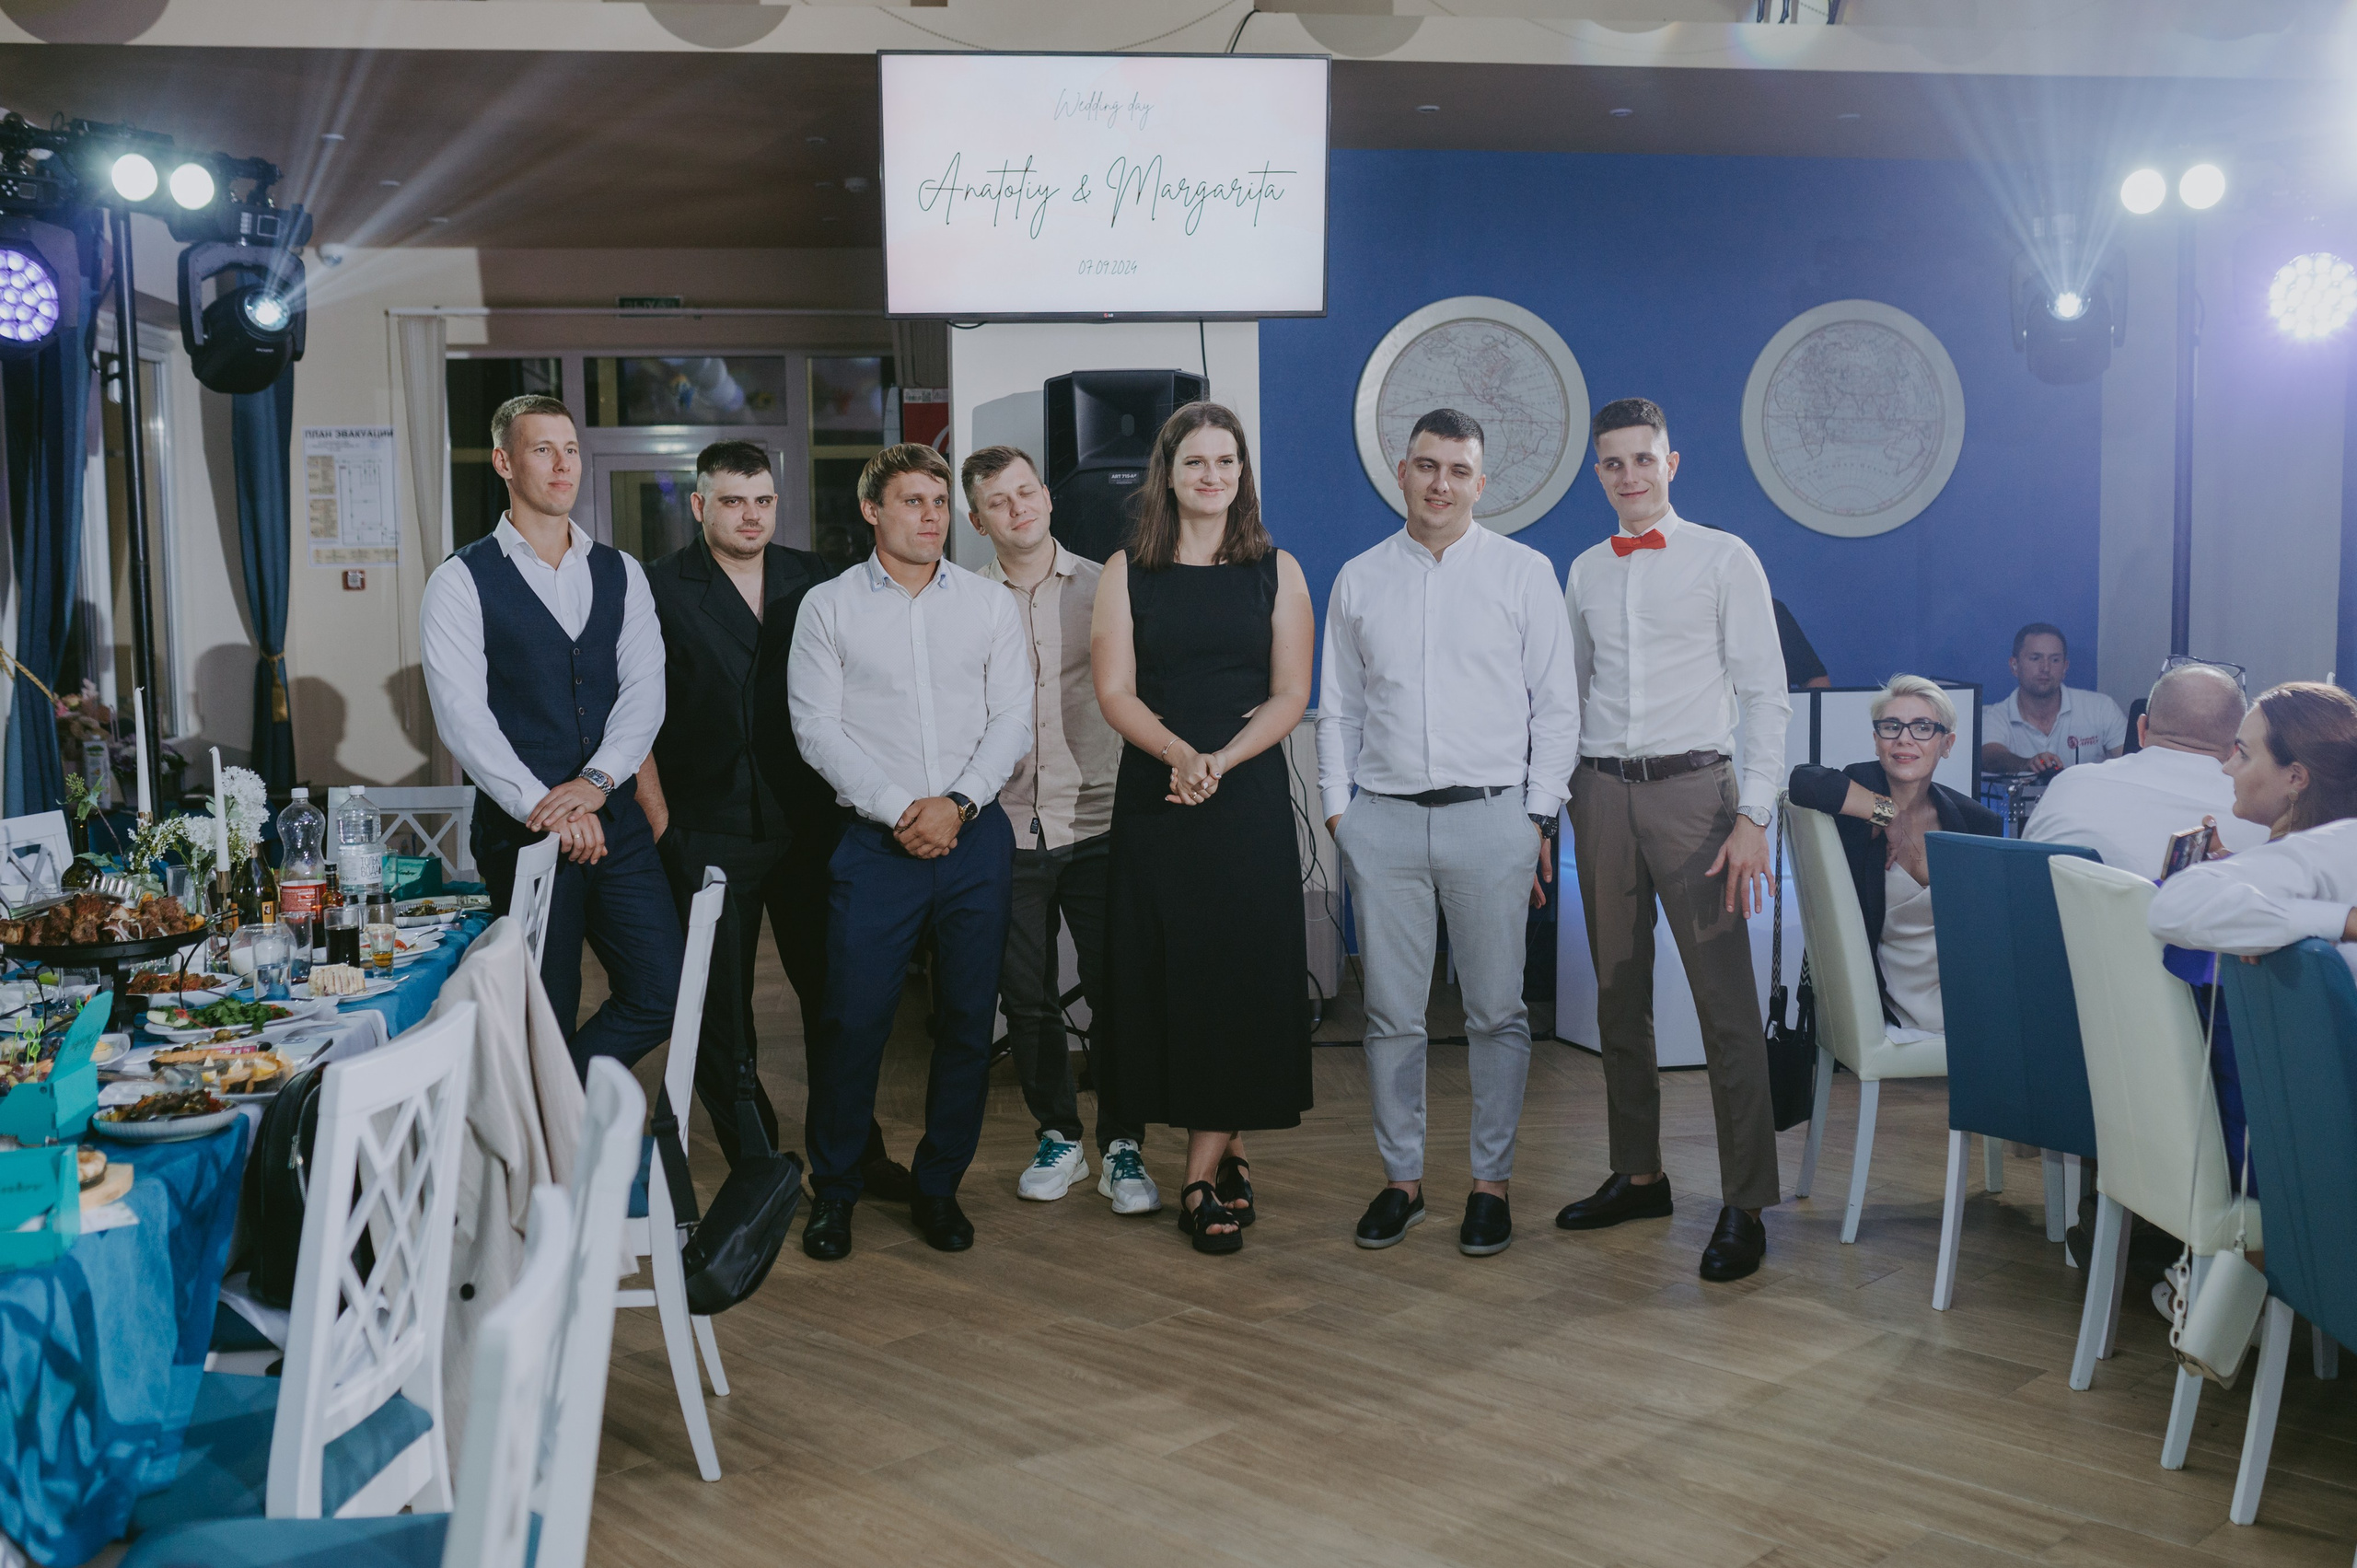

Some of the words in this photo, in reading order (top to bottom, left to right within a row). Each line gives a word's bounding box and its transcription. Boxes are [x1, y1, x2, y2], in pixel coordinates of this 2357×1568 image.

[1053, 87, 1123, 129] Wedding
[1127, 90, 1155, 131] day
[918, 151, 1061, 239] Anatoliy
[1072, 173, 1092, 203] &
[1106, 154, 1297, 236] Margarita
[1077, 259, 1138, 275] 07.09.2024
[305, 429, 332, 438] ПЛАН
[334, 428, 394, 440] ЭВАКУАЦИИ
[360, 854, 381, 866] ТОЛЬК
